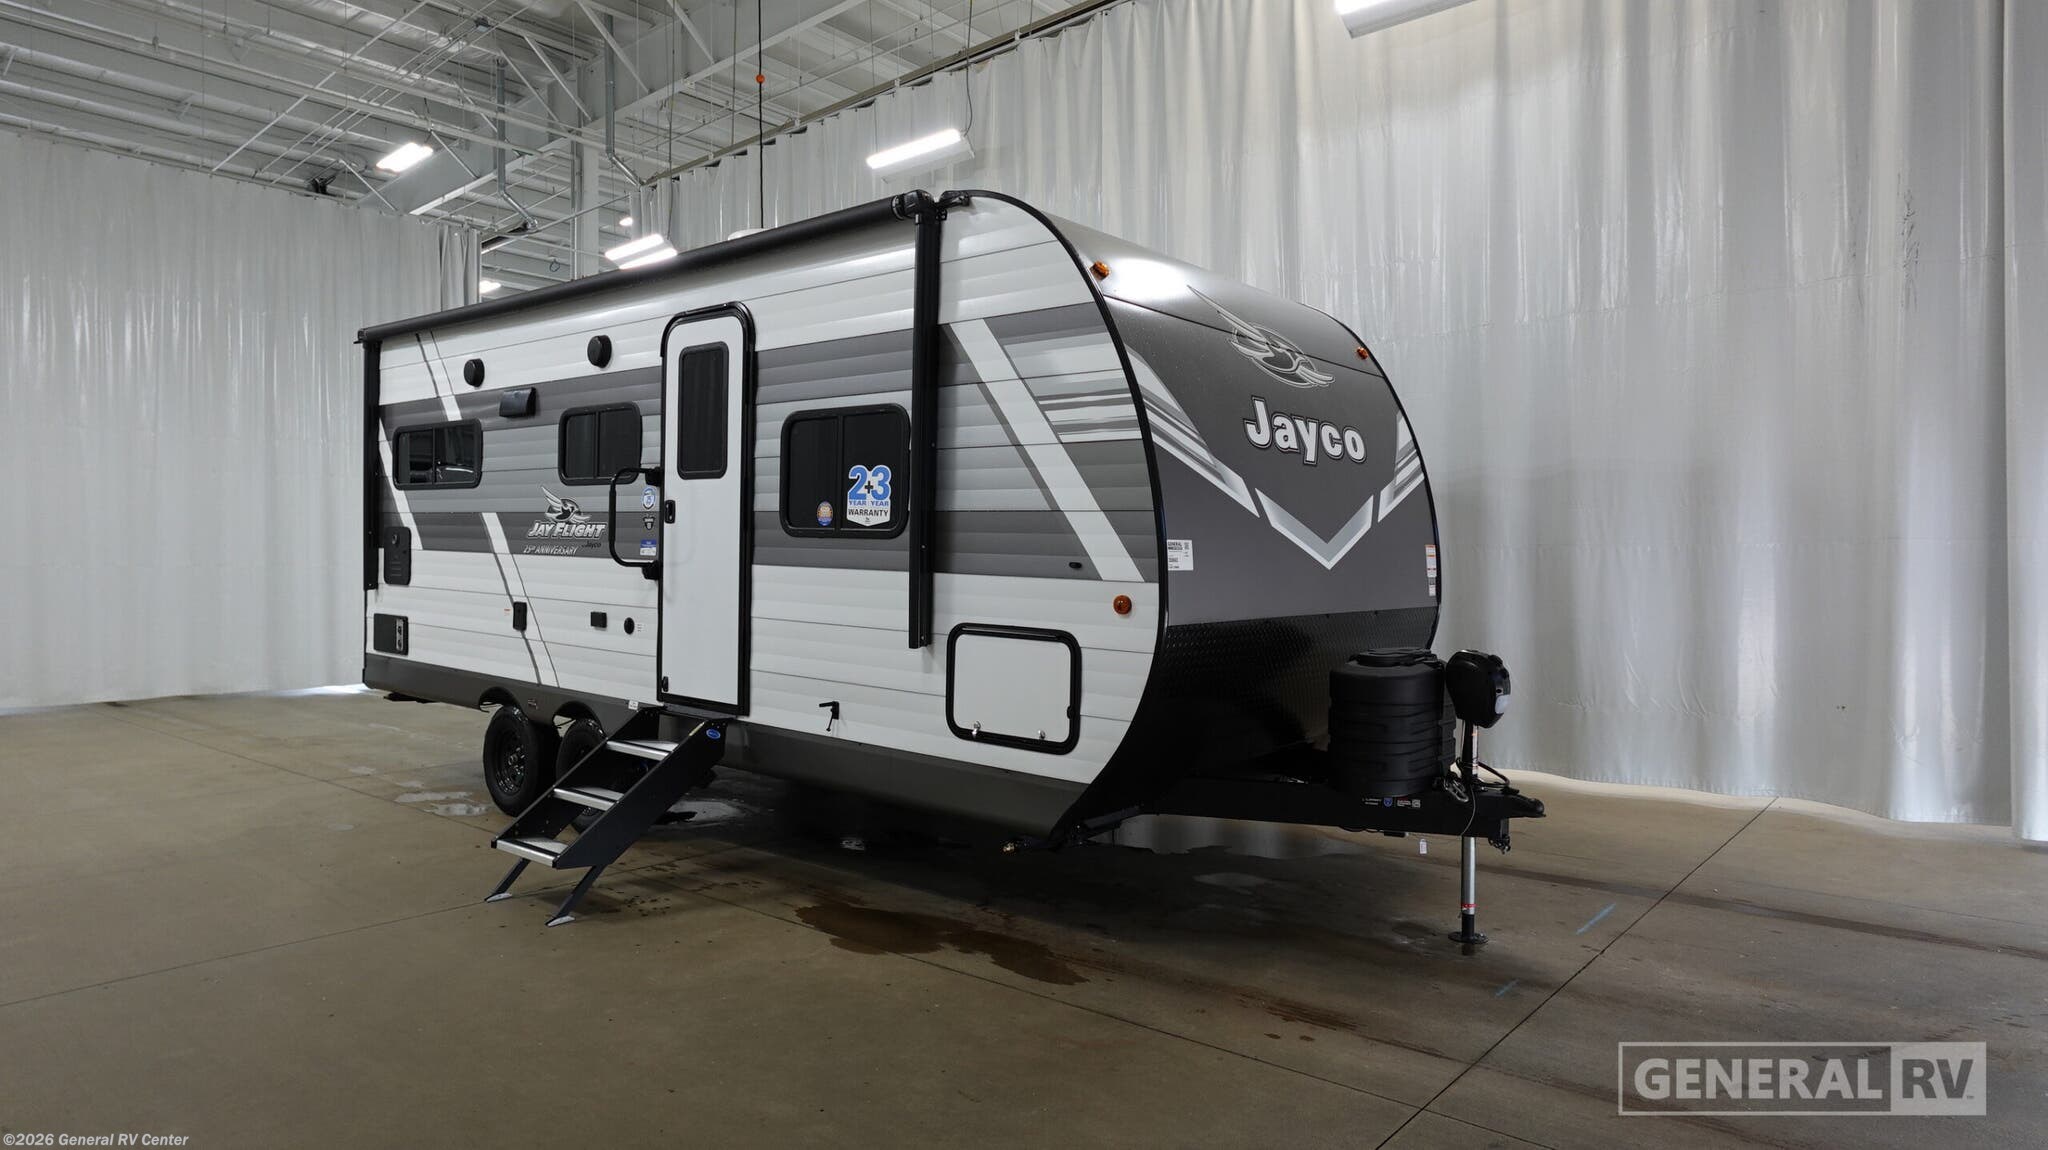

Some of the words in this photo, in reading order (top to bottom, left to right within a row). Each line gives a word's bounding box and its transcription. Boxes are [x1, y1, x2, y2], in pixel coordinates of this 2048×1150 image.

[1244, 397, 1366, 464] Jayco
[848, 508, 888, 517] WARRANTY
[528, 522, 554, 538] JAY
[552, 522, 606, 539] FLIGHT
[535, 546, 578, 555] ANNIVERSARY
